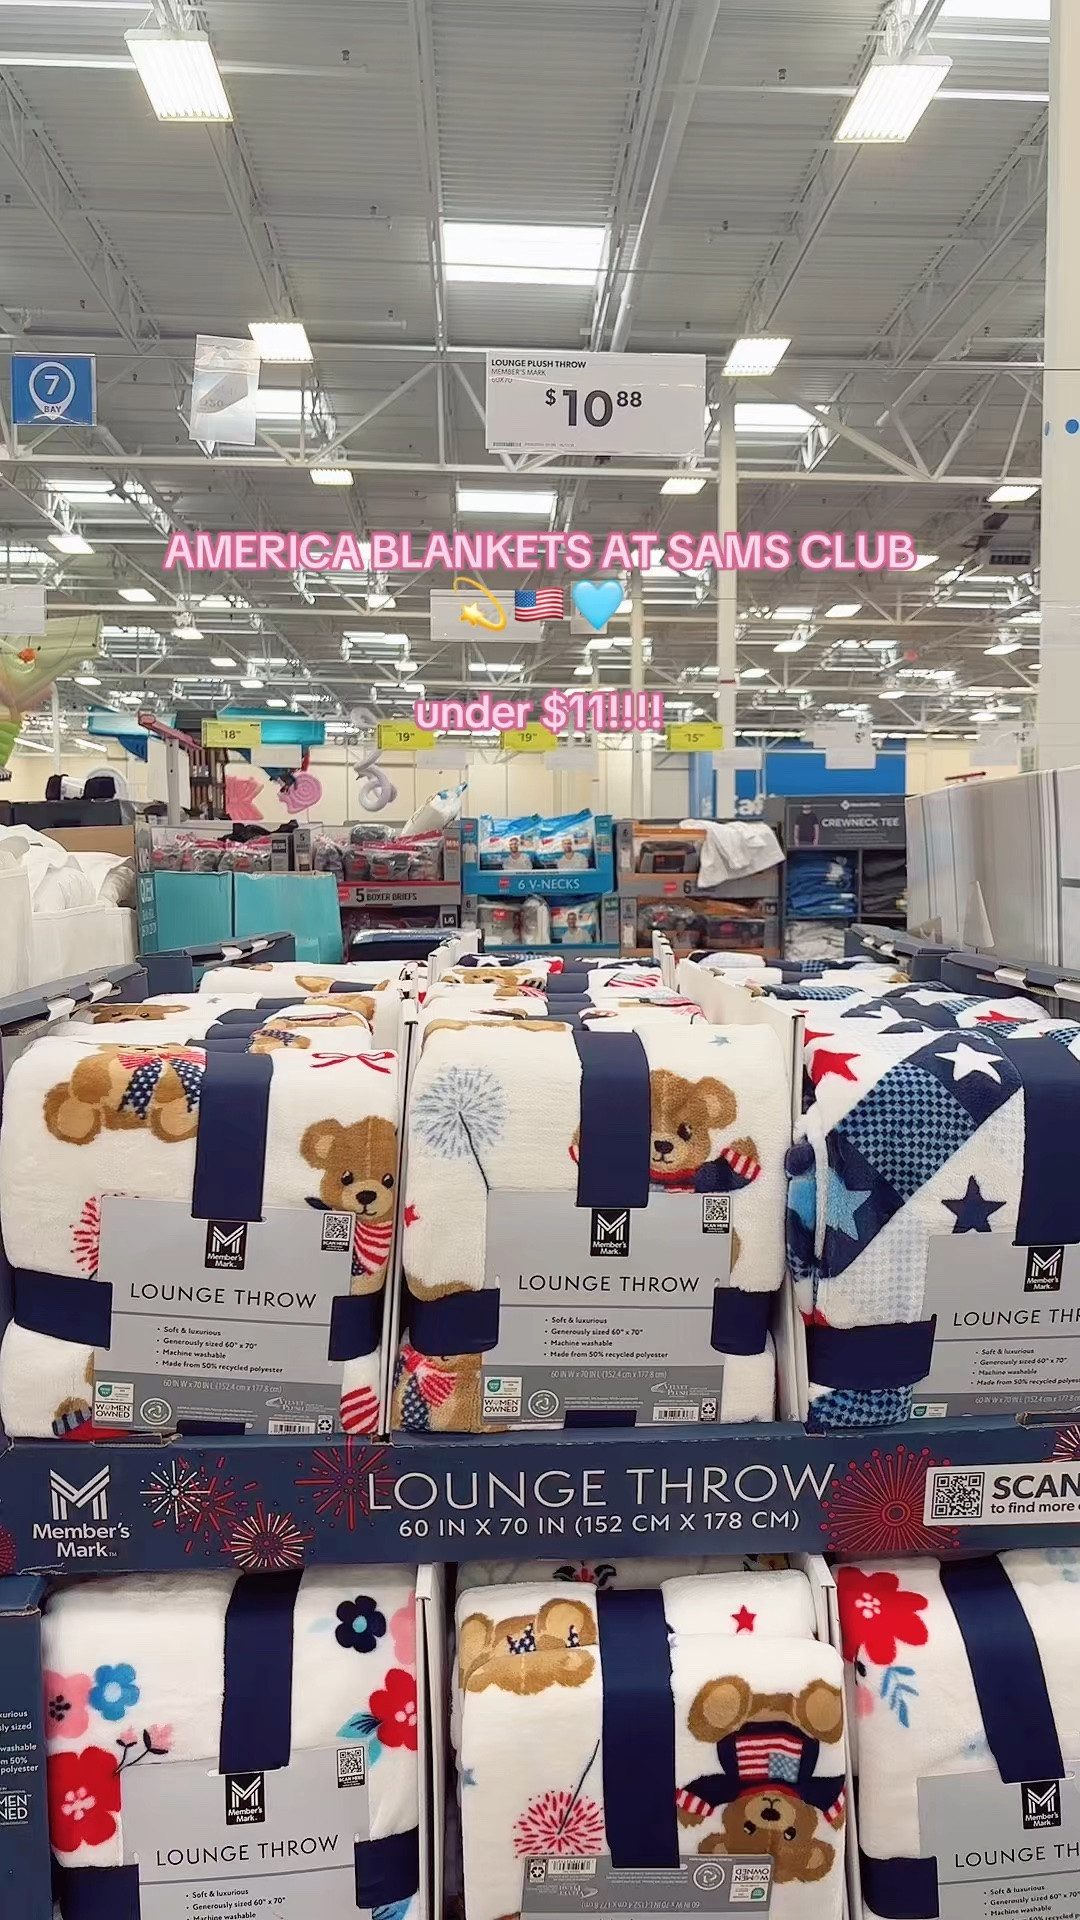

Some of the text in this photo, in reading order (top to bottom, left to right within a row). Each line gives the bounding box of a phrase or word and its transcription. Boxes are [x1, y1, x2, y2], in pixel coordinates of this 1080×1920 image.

[491, 359, 587, 369] LOUNGE PLUSH THROW
[491, 368, 526, 376] MEMBER'S
[44, 374, 60, 395] 7
[43, 405, 62, 413] BAY
[821, 817, 900, 827] CREWNECK TEE
[518, 879, 525, 890] 6
[529, 878, 580, 890] V-NECKS
[683, 880, 692, 894] 6
[355, 888, 365, 902] 5
[592, 1240, 627, 1249] Member's
[207, 1252, 243, 1262] Member's
[518, 1274, 700, 1293] LOUNGE THROW
[1026, 1277, 1059, 1285] Member's
[131, 1283, 317, 1309] LOUNGE THROW
[551, 1316, 608, 1324] Soft & luxurious
[953, 1309, 1041, 1327] LOUNGE
[163, 1326, 180, 1334] Soft
[188, 1327, 222, 1336] luxurious
[551, 1328, 591, 1337] Generously
[592, 1328, 609, 1336] sized
[163, 1337, 204, 1348] Generously
[204, 1340, 224, 1348] sized
[550, 1339, 613, 1347] Machine washable
[163, 1349, 227, 1359] Machine washable
[550, 1350, 669, 1360] Made from 50% recycled polyester
[162, 1360, 283, 1374] Made from 50% recycled polyester
[163, 1379, 172, 1387] 60
[179, 1380, 188, 1388] W
[269, 1385, 282, 1393] cm)
[95, 1410, 130, 1418] OWNED
[368, 1462, 835, 1512] LOUNGE THROW
[992, 1472, 1080, 1500] SCAN
[991, 1501, 1075, 1514] to find more
[399, 1510, 800, 1538] 60 IN X 70 IN (152 CM X 178 CM)
[32, 1522, 130, 1540] Member's
[11, 1722, 32, 1731] sized
[0, 1743, 37, 1752] washable
[10, 1756, 28, 1765] 50%
[0, 1765, 39, 1775] polyester
[228, 1806, 263, 1816] Member's
[1025, 1812, 1059, 1822] Member's
[156, 1834, 339, 1867] LOUNGE THROW
[955, 1846, 1046, 1868] LOUNGE
[735, 1867, 770, 1876] OWNED
[192, 1891, 207, 1899] Soft
[216, 1889, 249, 1897] luxurious
[990, 1887, 1005, 1895] Soft
[1013, 1885, 1045, 1893] luxurious
[192, 1901, 233, 1911] Generously
[234, 1899, 253, 1908] sized
[990, 1896, 1029, 1906] Generously
[223, 1911, 257, 1920] washable
[990, 1905, 1052, 1917] Machine washable
